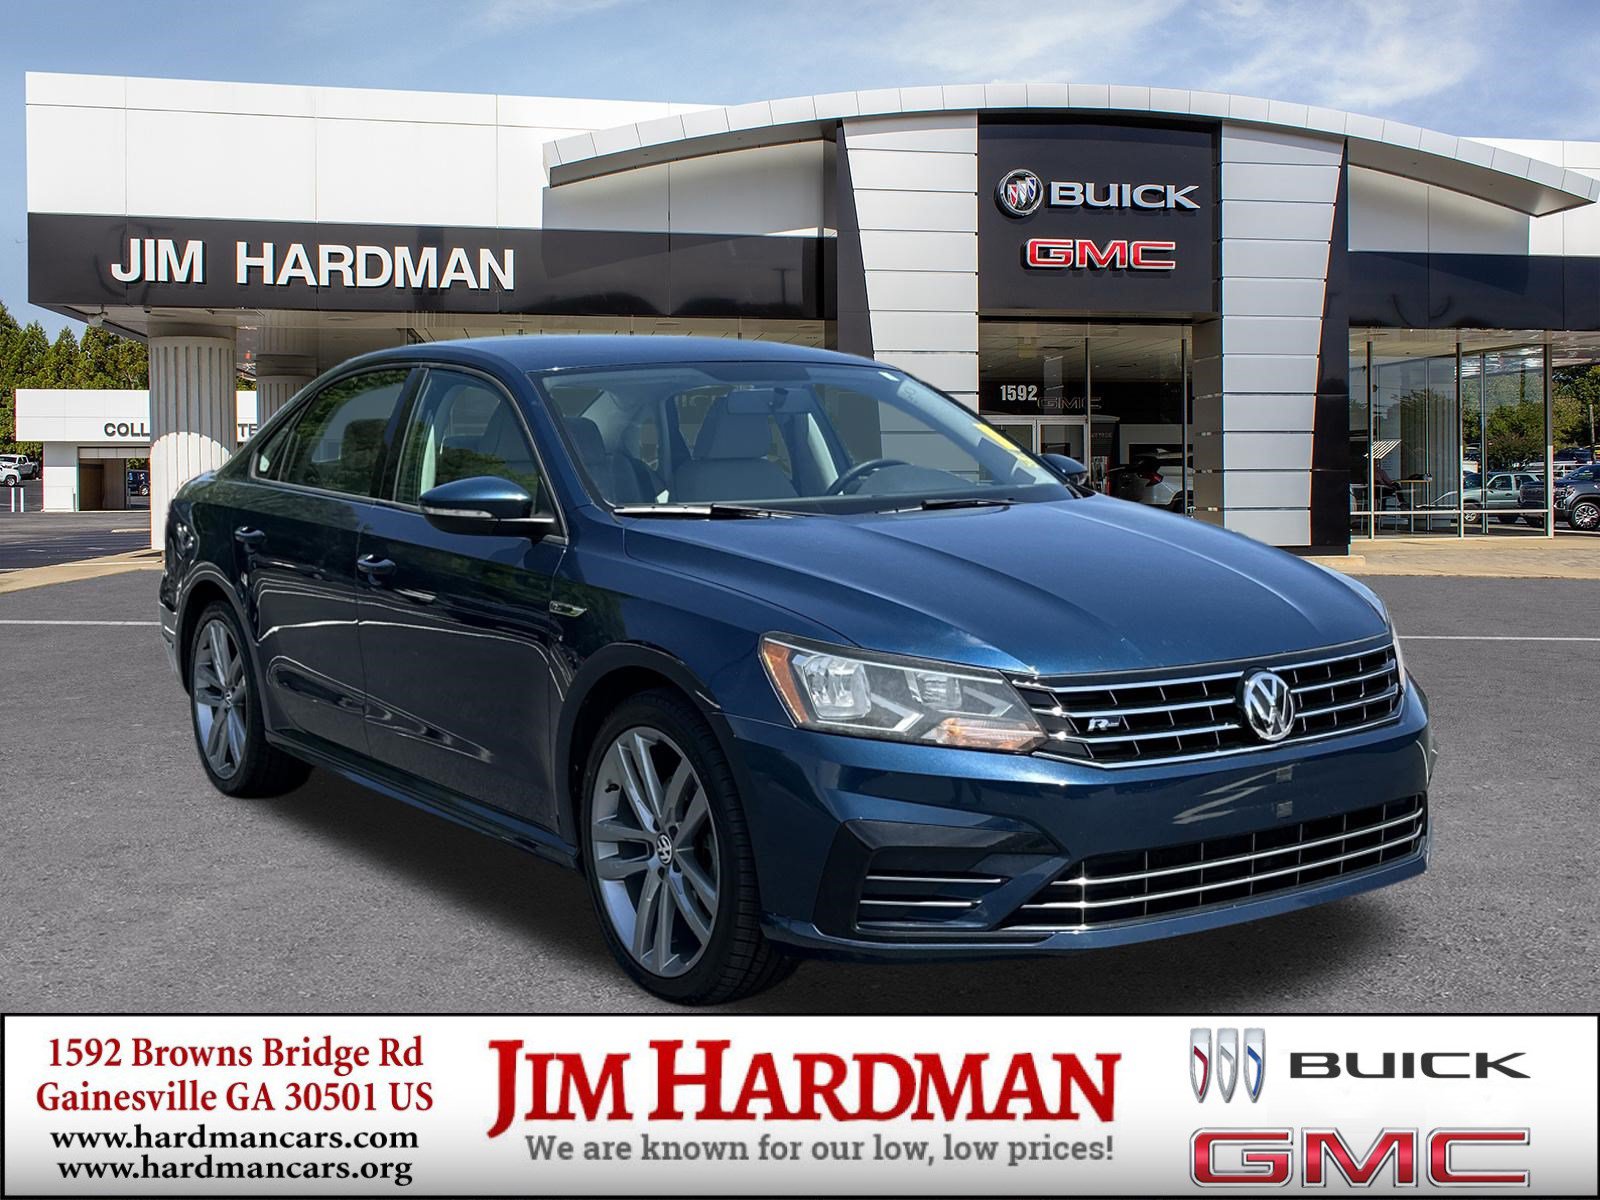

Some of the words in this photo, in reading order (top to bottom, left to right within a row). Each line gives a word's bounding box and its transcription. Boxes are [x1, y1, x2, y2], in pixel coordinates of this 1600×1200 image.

[1051, 181, 1200, 210] BUICK
[111, 238, 204, 284] JIM
[236, 241, 515, 291] HARDMAN
[1025, 238, 1176, 270] GMC
[1000, 384, 1038, 401] 1592
